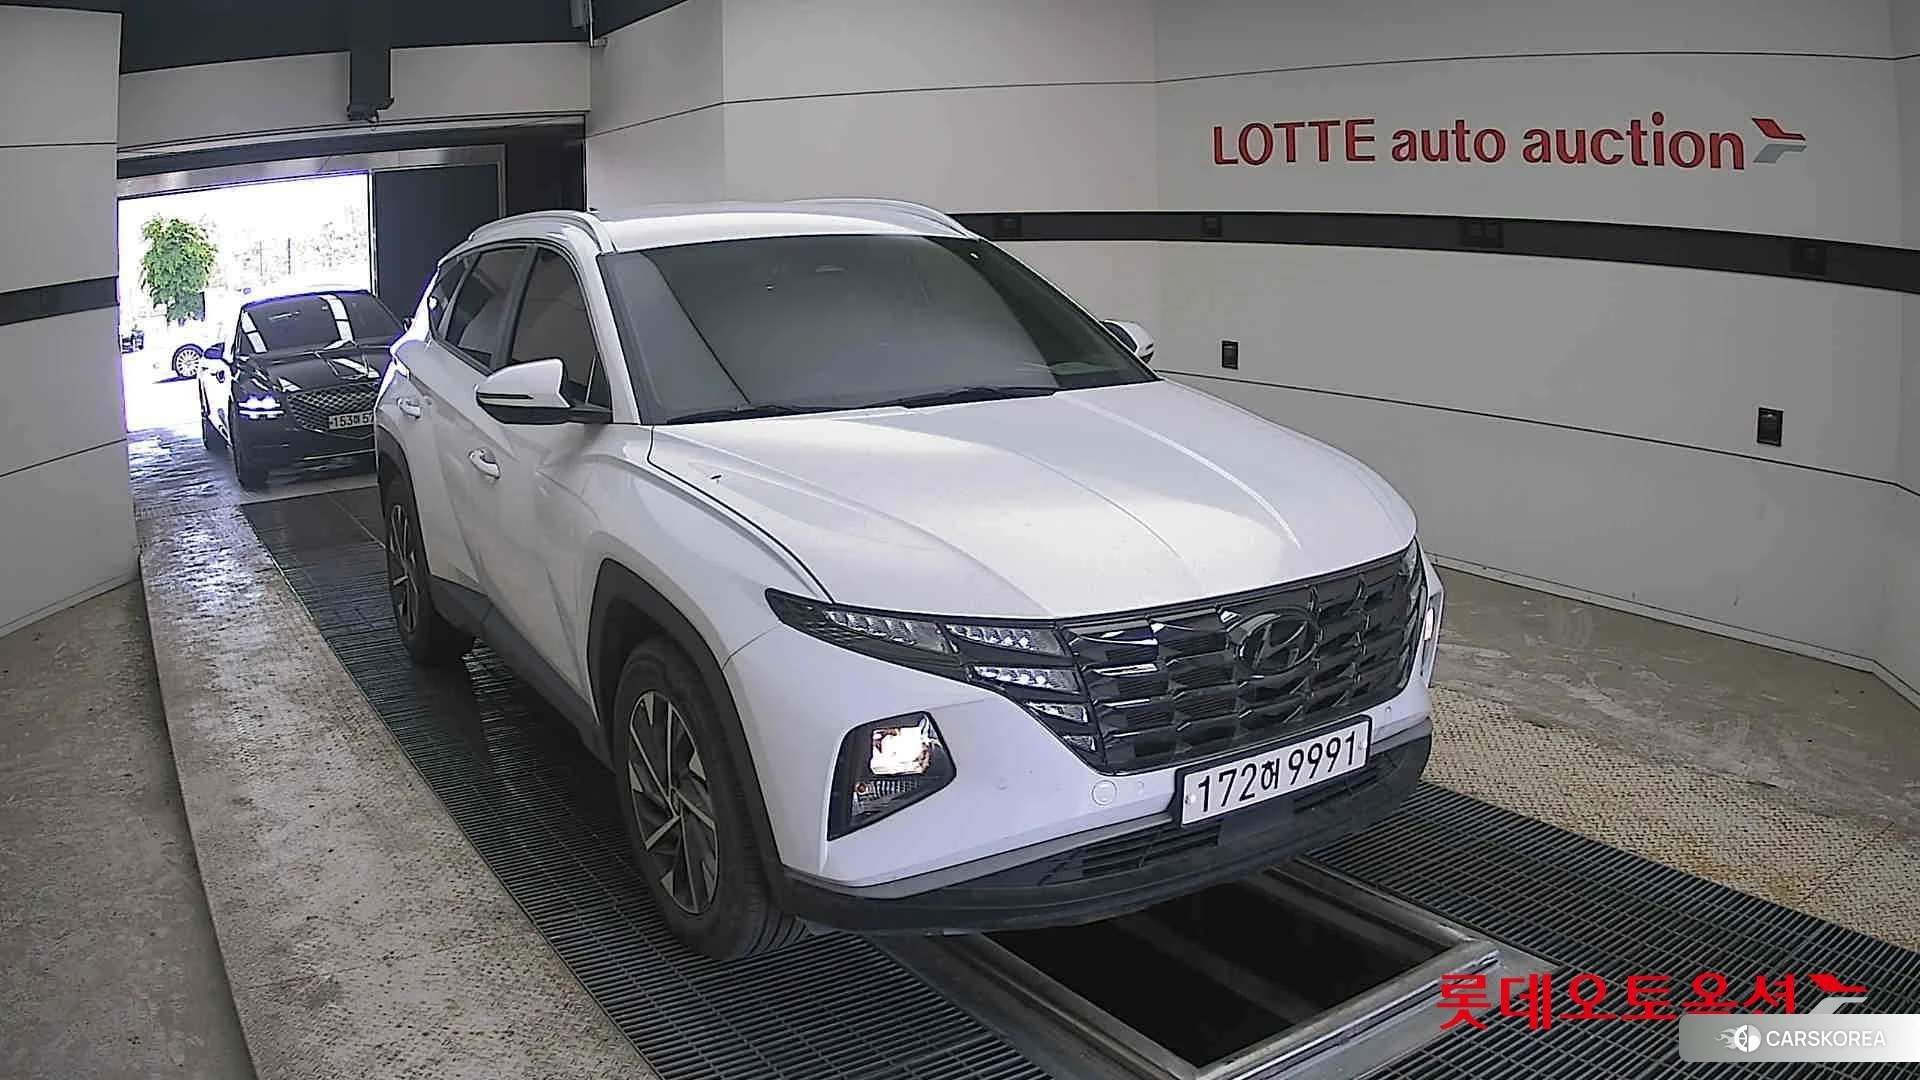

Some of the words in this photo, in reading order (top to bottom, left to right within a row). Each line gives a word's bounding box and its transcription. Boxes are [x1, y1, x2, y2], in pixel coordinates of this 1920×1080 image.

[1212, 118, 1376, 166] LOTTE
[1391, 117, 1506, 164] auto
[1521, 111, 1745, 170] auction
